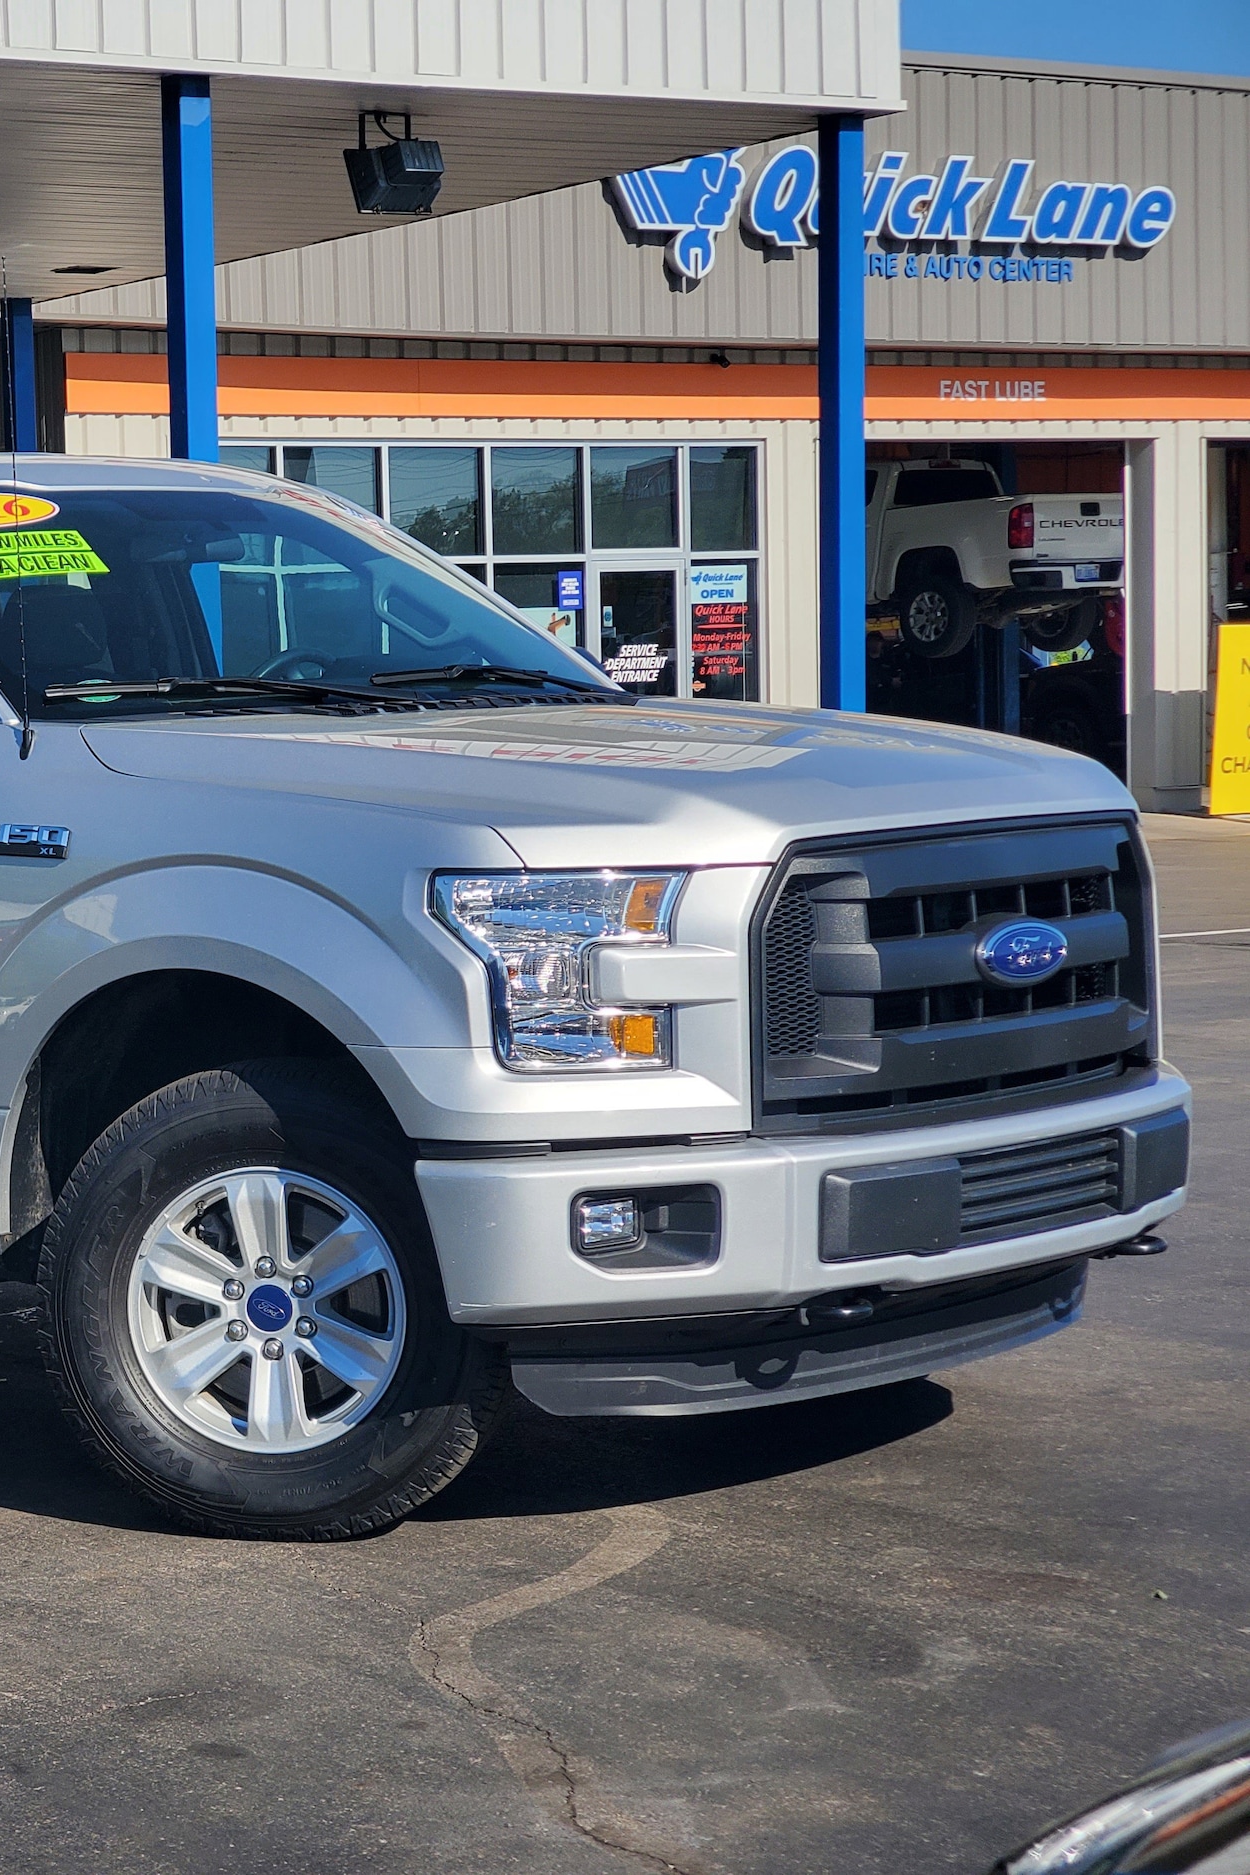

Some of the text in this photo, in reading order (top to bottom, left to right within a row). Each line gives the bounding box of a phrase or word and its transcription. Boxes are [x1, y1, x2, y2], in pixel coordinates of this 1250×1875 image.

[980, 159, 1176, 248] Lane
[863, 253, 1074, 283] IRE & AUTO CENTER
[939, 380, 1047, 402] FAST LUBE
[1039, 519, 1124, 529] CHEVROLE
[16, 532, 79, 549] MILES
[19, 553, 90, 573] CLEAN
[702, 573, 744, 583] Quick Lane
[700, 588, 735, 600] OPEN
[695, 604, 749, 617] Quick Lane
[709, 614, 735, 624] HOURS
[619, 643, 659, 658] SERVICE
[605, 656, 669, 671] DEPARTMENT
[703, 655, 740, 666] Saturday
[610, 669, 660, 683] ENTRANCE
[699, 666, 706, 676] 8
[706, 665, 721, 675] AM
[39, 847, 57, 856] XL
[258, 1301, 280, 1317] Ford
